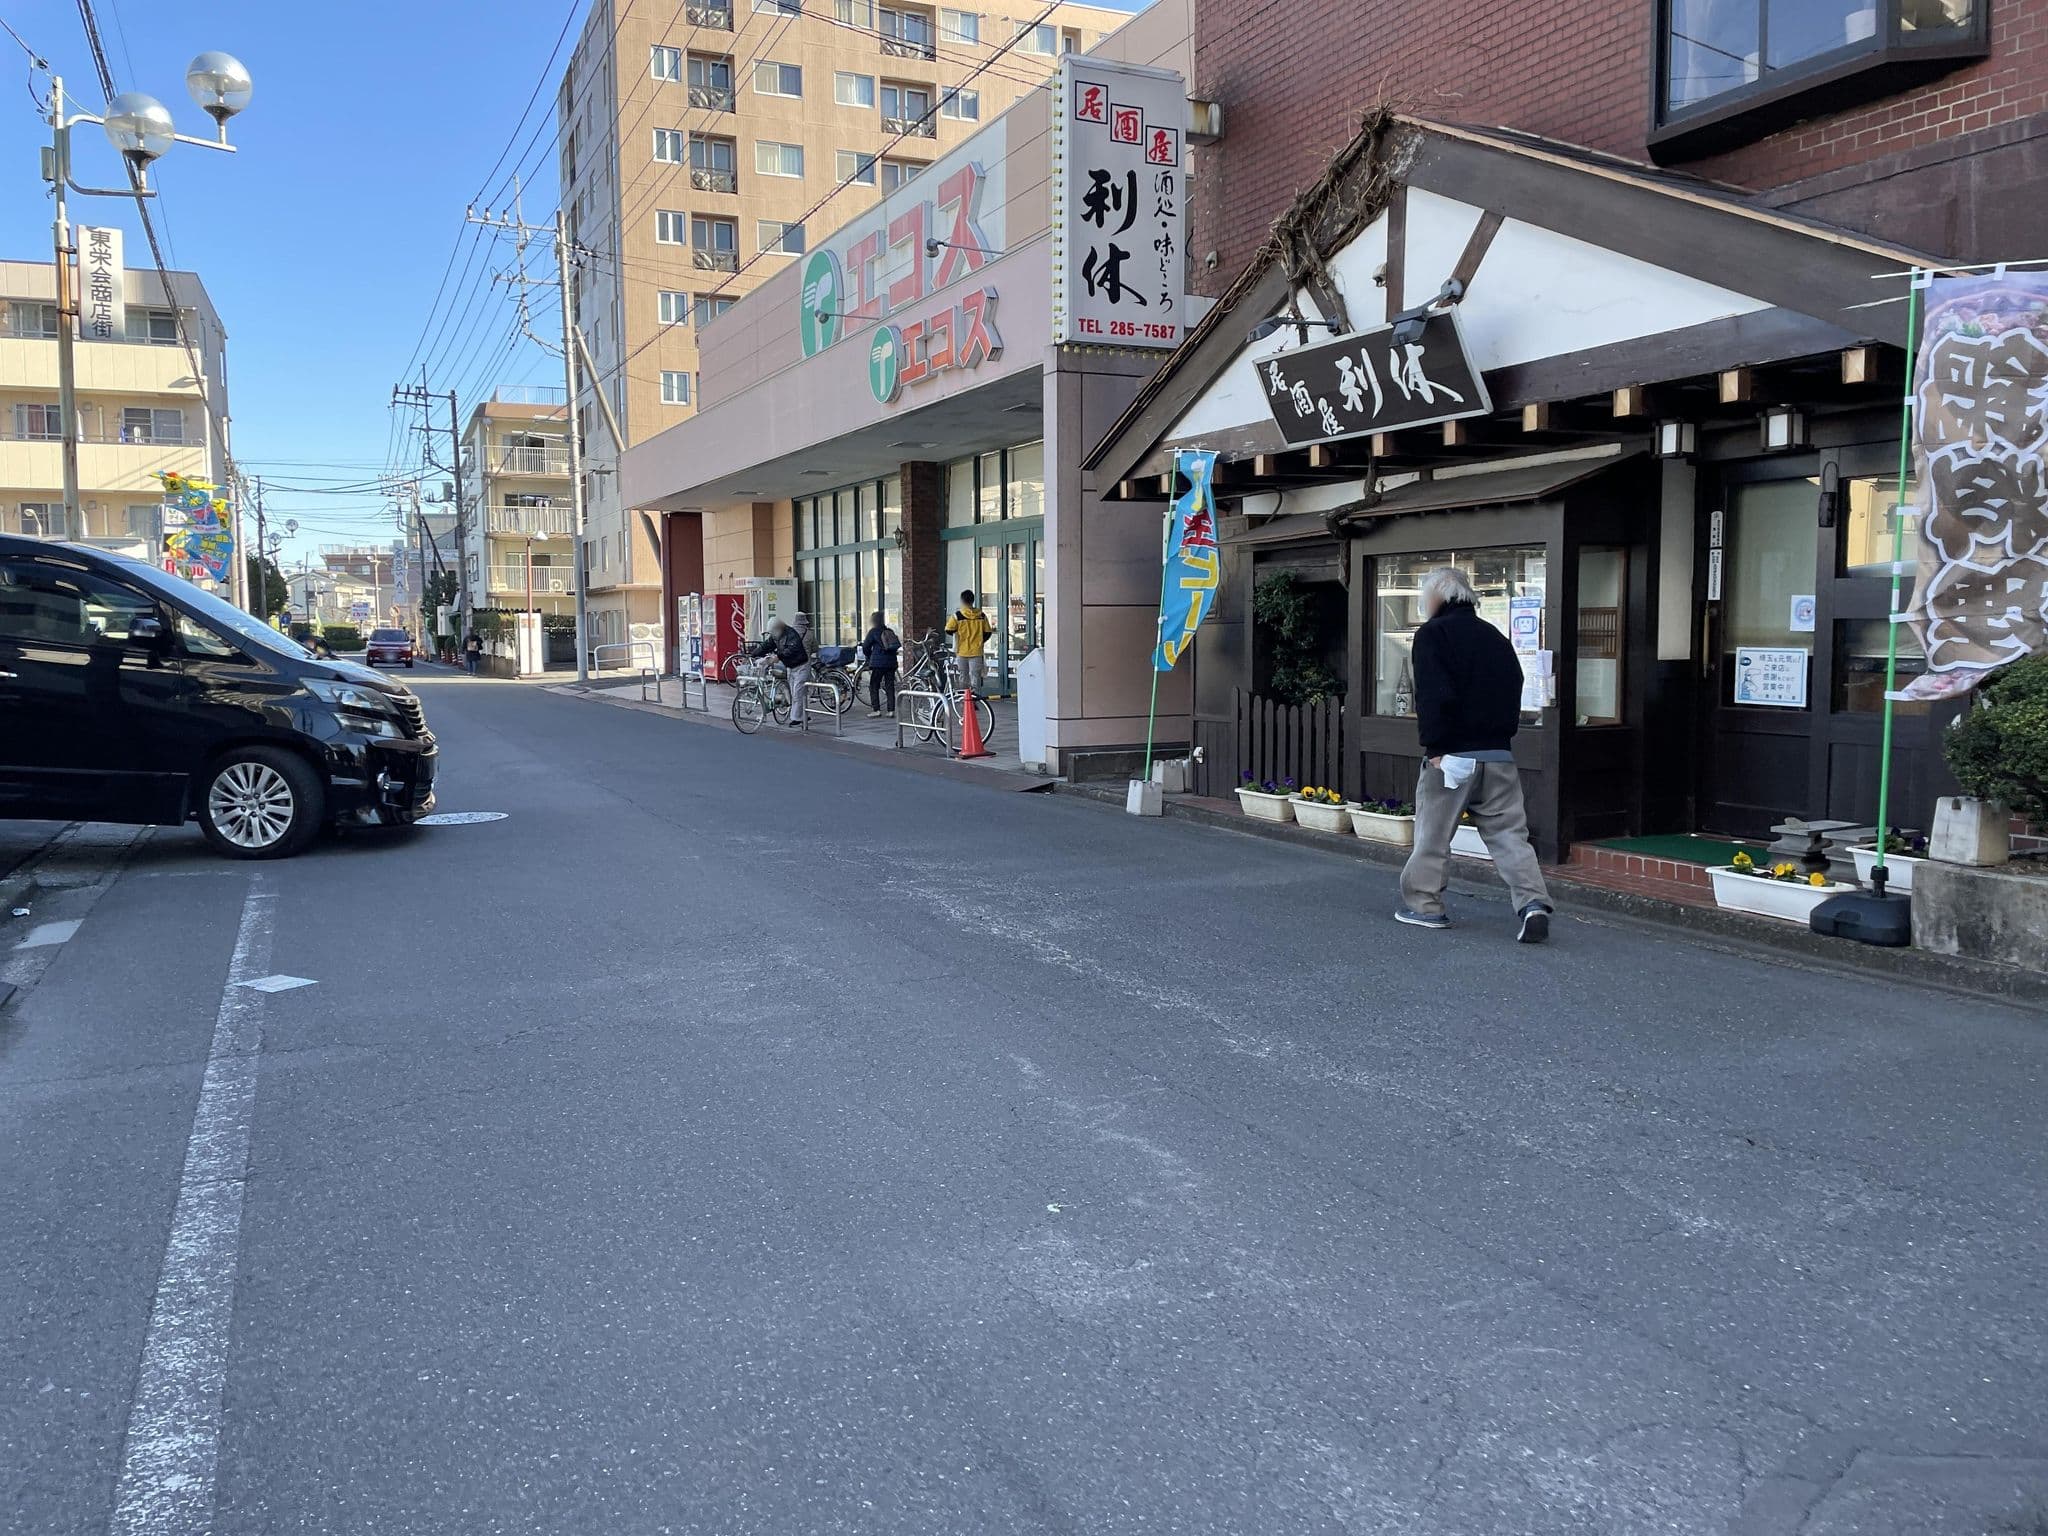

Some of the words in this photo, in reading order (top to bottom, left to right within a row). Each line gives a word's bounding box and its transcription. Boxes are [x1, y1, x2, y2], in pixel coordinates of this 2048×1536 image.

[1078, 86, 1173, 163] 居酒屋
[89, 229, 114, 338] 東栄会商店街
[845, 163, 988, 336] エコス
[1080, 168, 1147, 307] 利休
[900, 287, 997, 385] エコス
[1078, 318, 1103, 334] TEL
[1110, 320, 1176, 339] 285-7587
[1334, 343, 1464, 420] 利休
